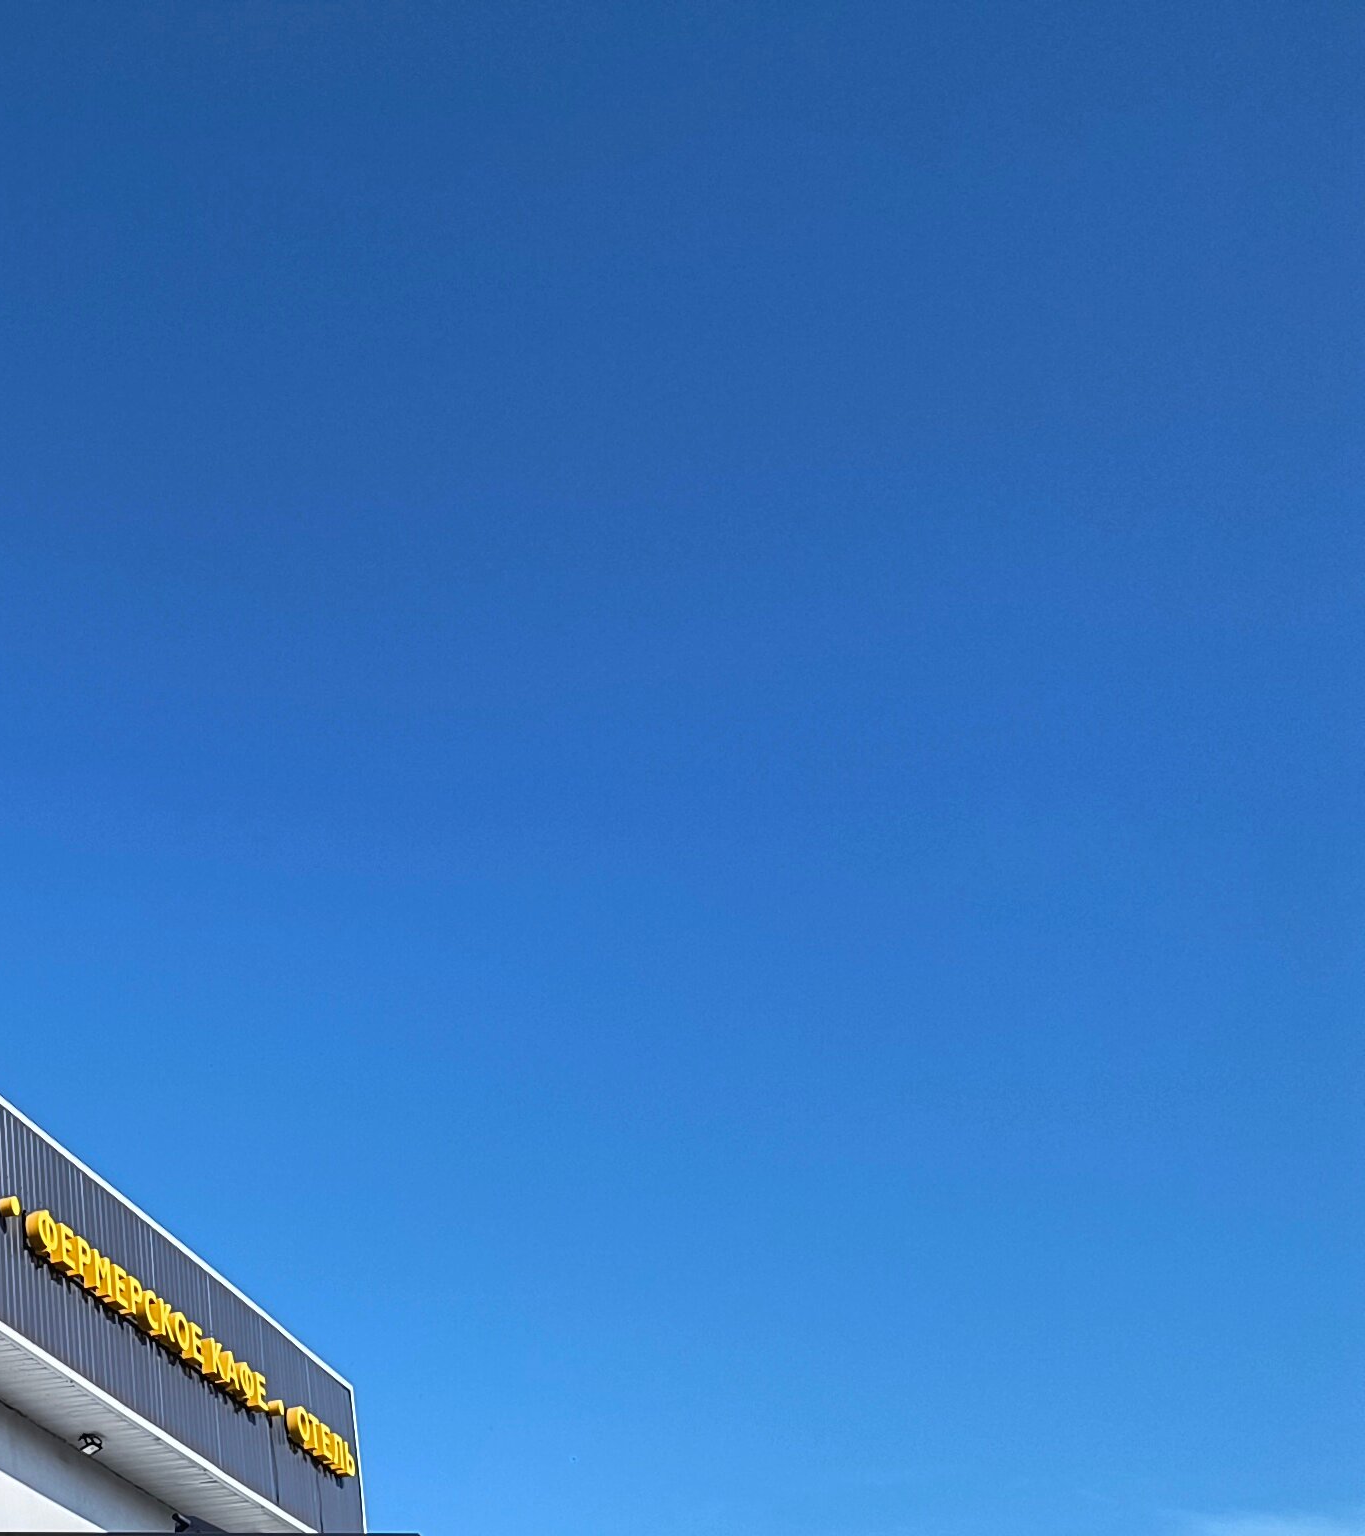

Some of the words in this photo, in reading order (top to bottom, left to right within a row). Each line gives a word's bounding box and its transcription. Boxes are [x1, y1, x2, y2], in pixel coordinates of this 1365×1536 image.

[26, 1209, 205, 1364] ФЕРМЕРСКОЕ
[202, 1337, 269, 1411] КАФЕ
[287, 1405, 356, 1477] ОТЕЛЬ
